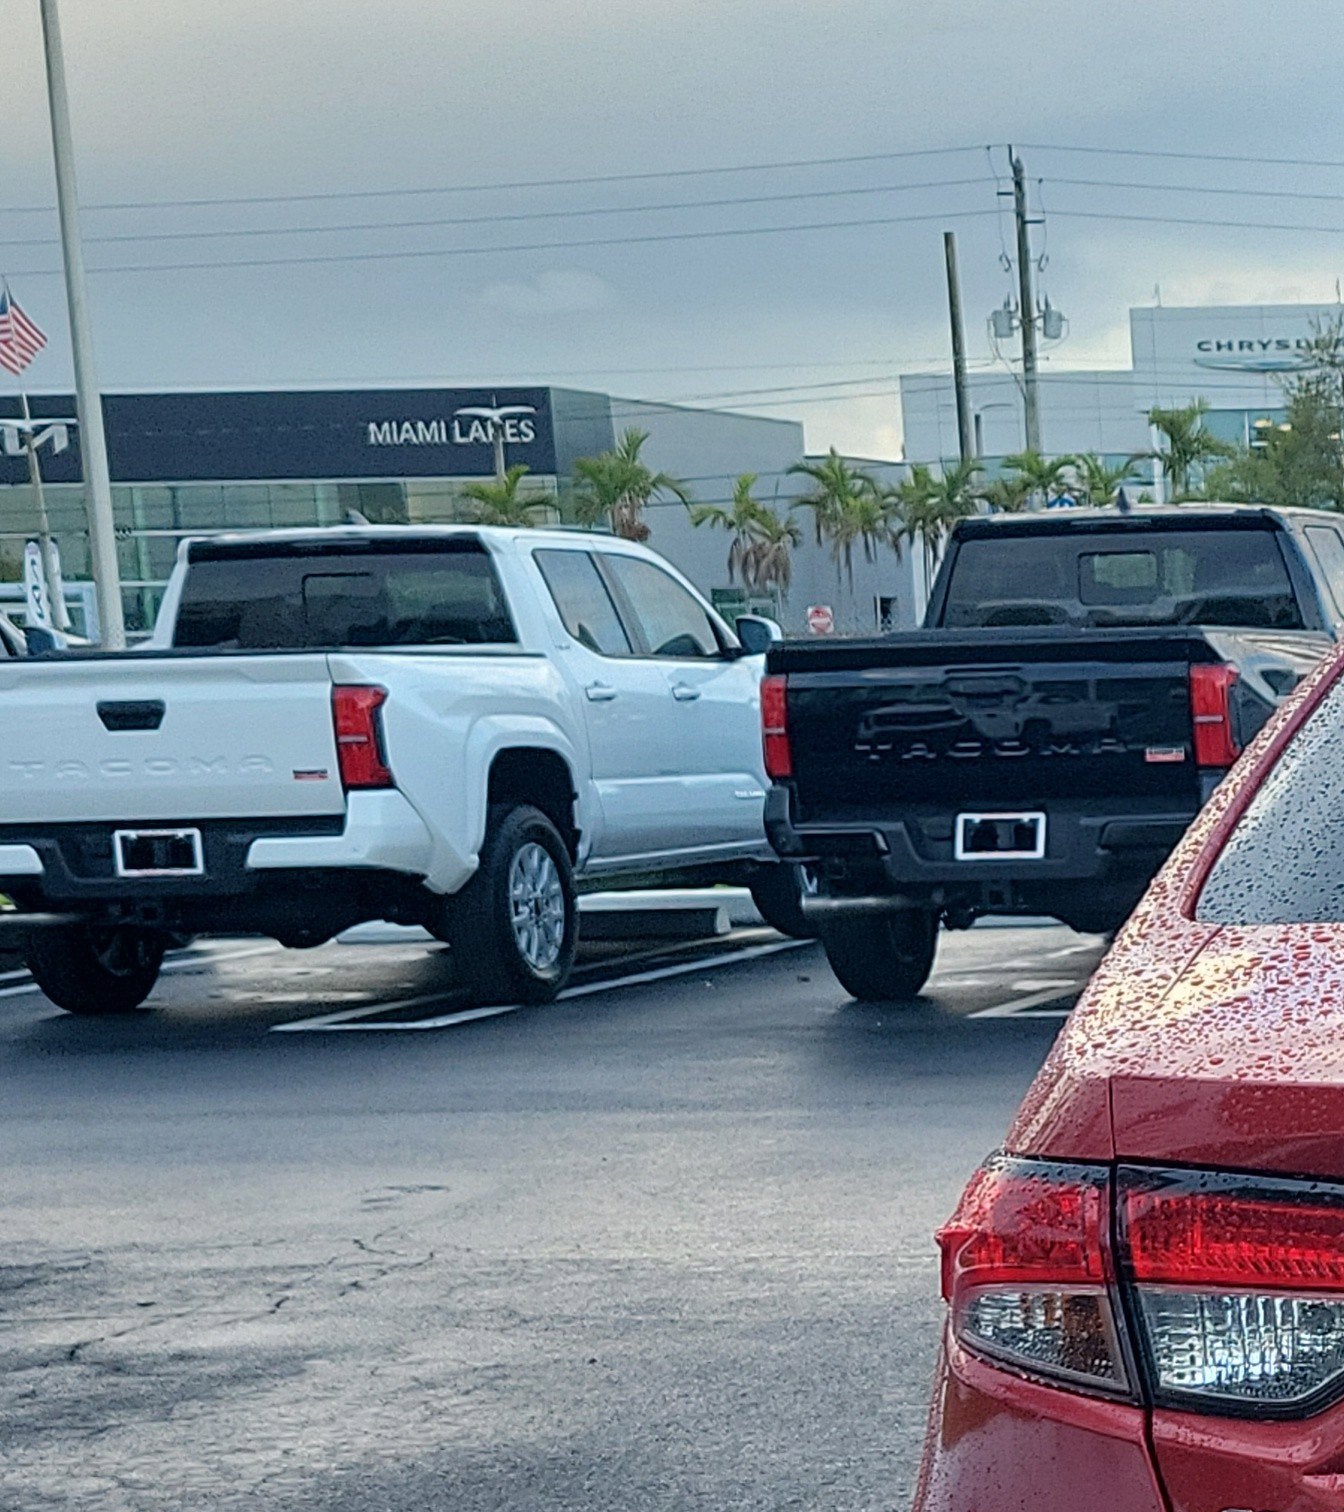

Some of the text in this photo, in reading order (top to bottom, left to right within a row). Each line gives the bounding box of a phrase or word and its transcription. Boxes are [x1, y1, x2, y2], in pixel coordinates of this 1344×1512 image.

[368, 420, 447, 445] MIAMI
[854, 740, 1128, 760] TACOMA
[9, 755, 274, 779] TACOMA
